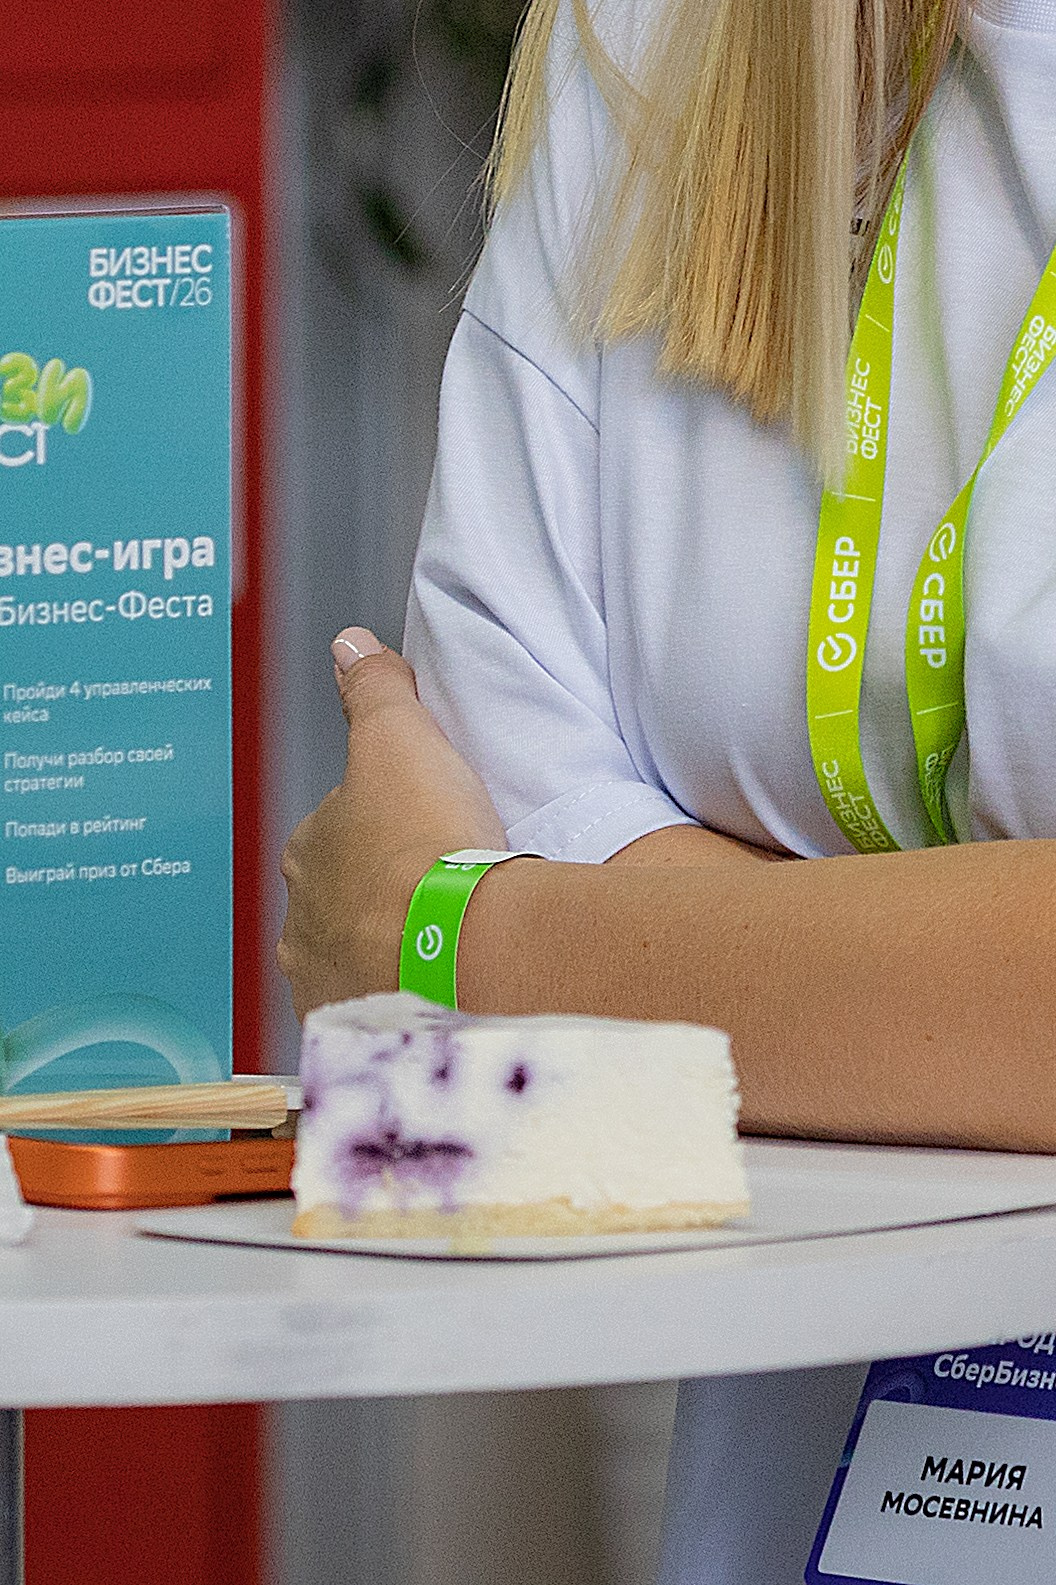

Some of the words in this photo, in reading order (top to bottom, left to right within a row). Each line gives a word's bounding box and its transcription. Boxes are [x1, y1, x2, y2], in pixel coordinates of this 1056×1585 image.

[88, 245, 213, 277] БИЗНЕС
[87, 277, 213, 309] ФЕСТ/26
[1012, 315, 1045, 379] ФЕСТ
[861, 396, 882, 460] ФЕСТ
[827, 536, 861, 623] СБЕР
[0, 590, 213, 626] Бизнес-Феста
[919, 572, 946, 668] СБЕР
[3, 681, 65, 702] Пройди
[69, 680, 81, 696] 4
[83, 677, 212, 700] управленческих
[3, 705, 49, 724] кейса
[4, 751, 65, 771] Получи
[68, 747, 125, 768] разбор
[127, 743, 174, 762] своей
[4, 775, 84, 794] стратегии
[822, 759, 874, 849] БИЗНЕС
[848, 792, 889, 848] ФЕСТ
[5, 820, 66, 838] Попади
[69, 820, 80, 834] в
[83, 815, 147, 836] рейтинг
[6, 863, 74, 885] Выиграй
[78, 865, 116, 882] приз
[119, 862, 138, 877] от
[141, 857, 191, 877] Сбера
[919, 1455, 1027, 1491] МАРИЯ
[880, 1490, 1044, 1530] МОСЕВНИНА
